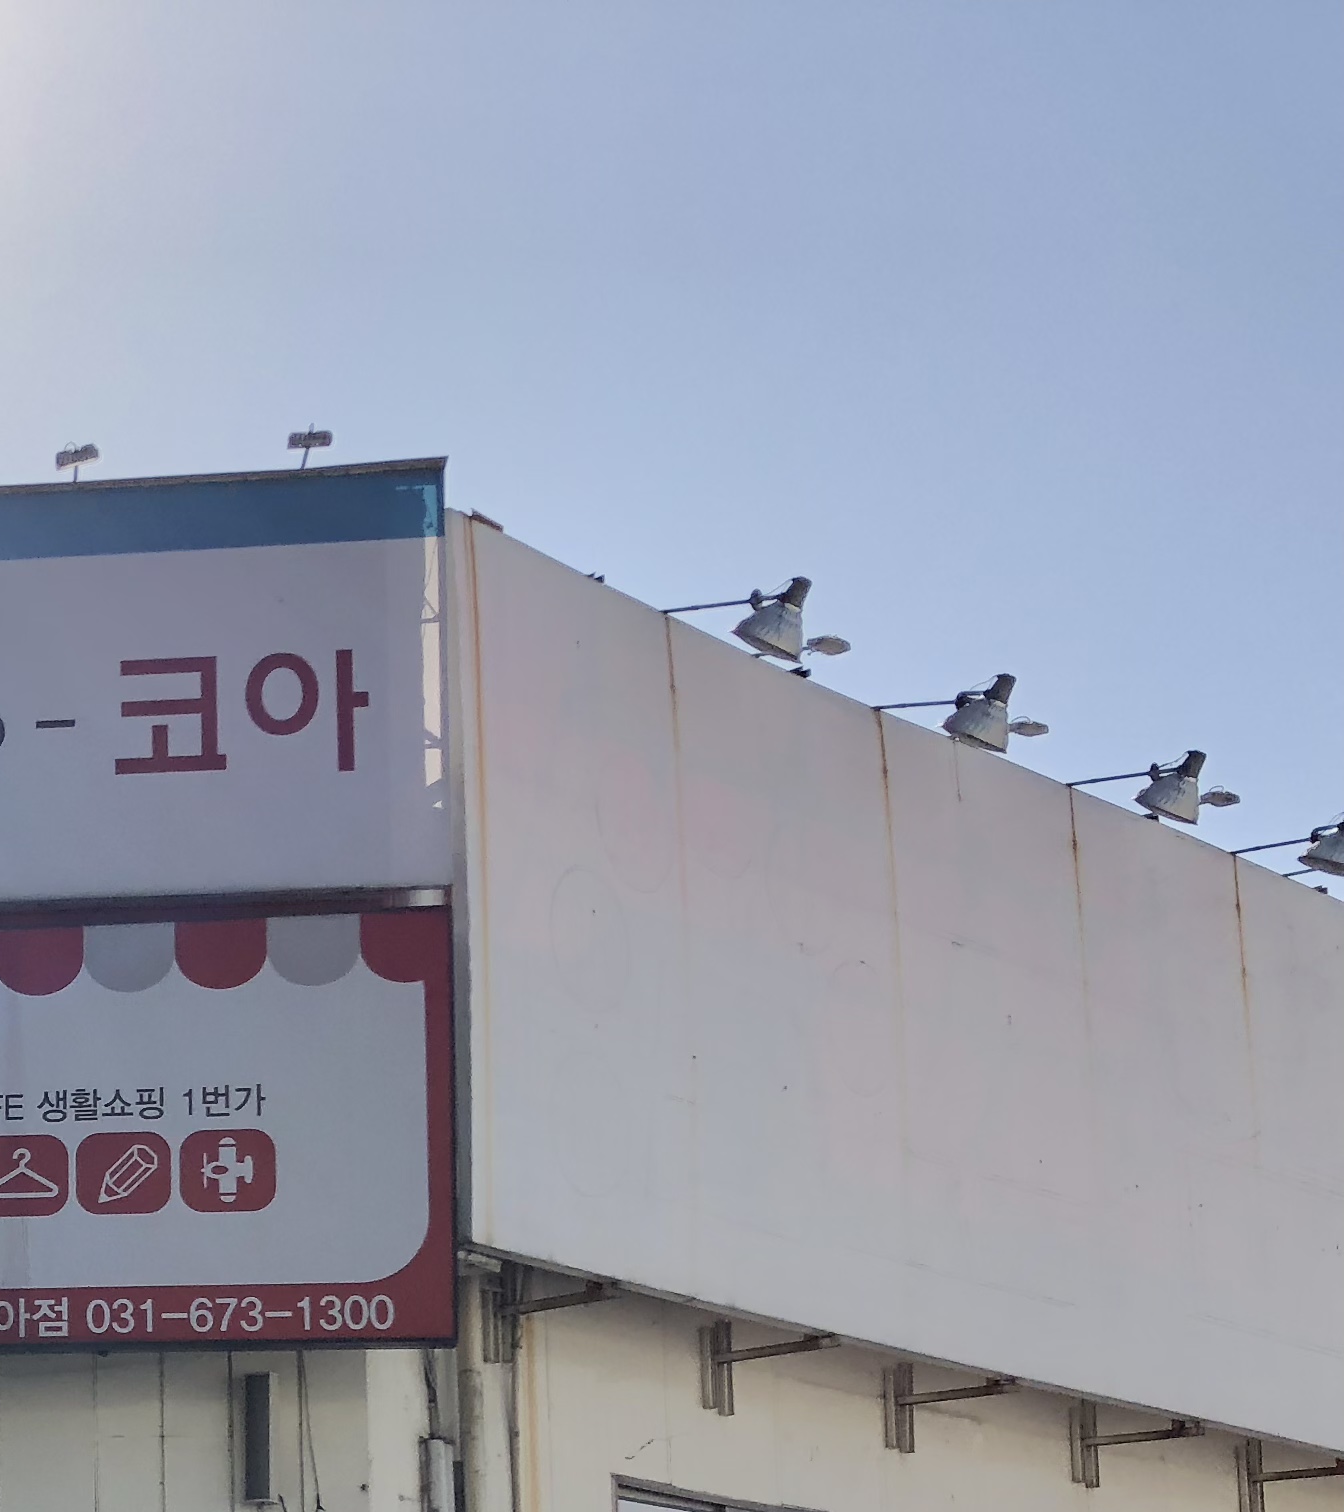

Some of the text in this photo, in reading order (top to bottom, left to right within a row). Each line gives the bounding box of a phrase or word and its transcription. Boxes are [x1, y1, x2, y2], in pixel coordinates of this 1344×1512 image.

[114, 648, 369, 775] 코아
[37, 1086, 166, 1124] 생활쇼핑
[182, 1082, 268, 1118] 1번가
[85, 1293, 395, 1335] 031-673-1300
